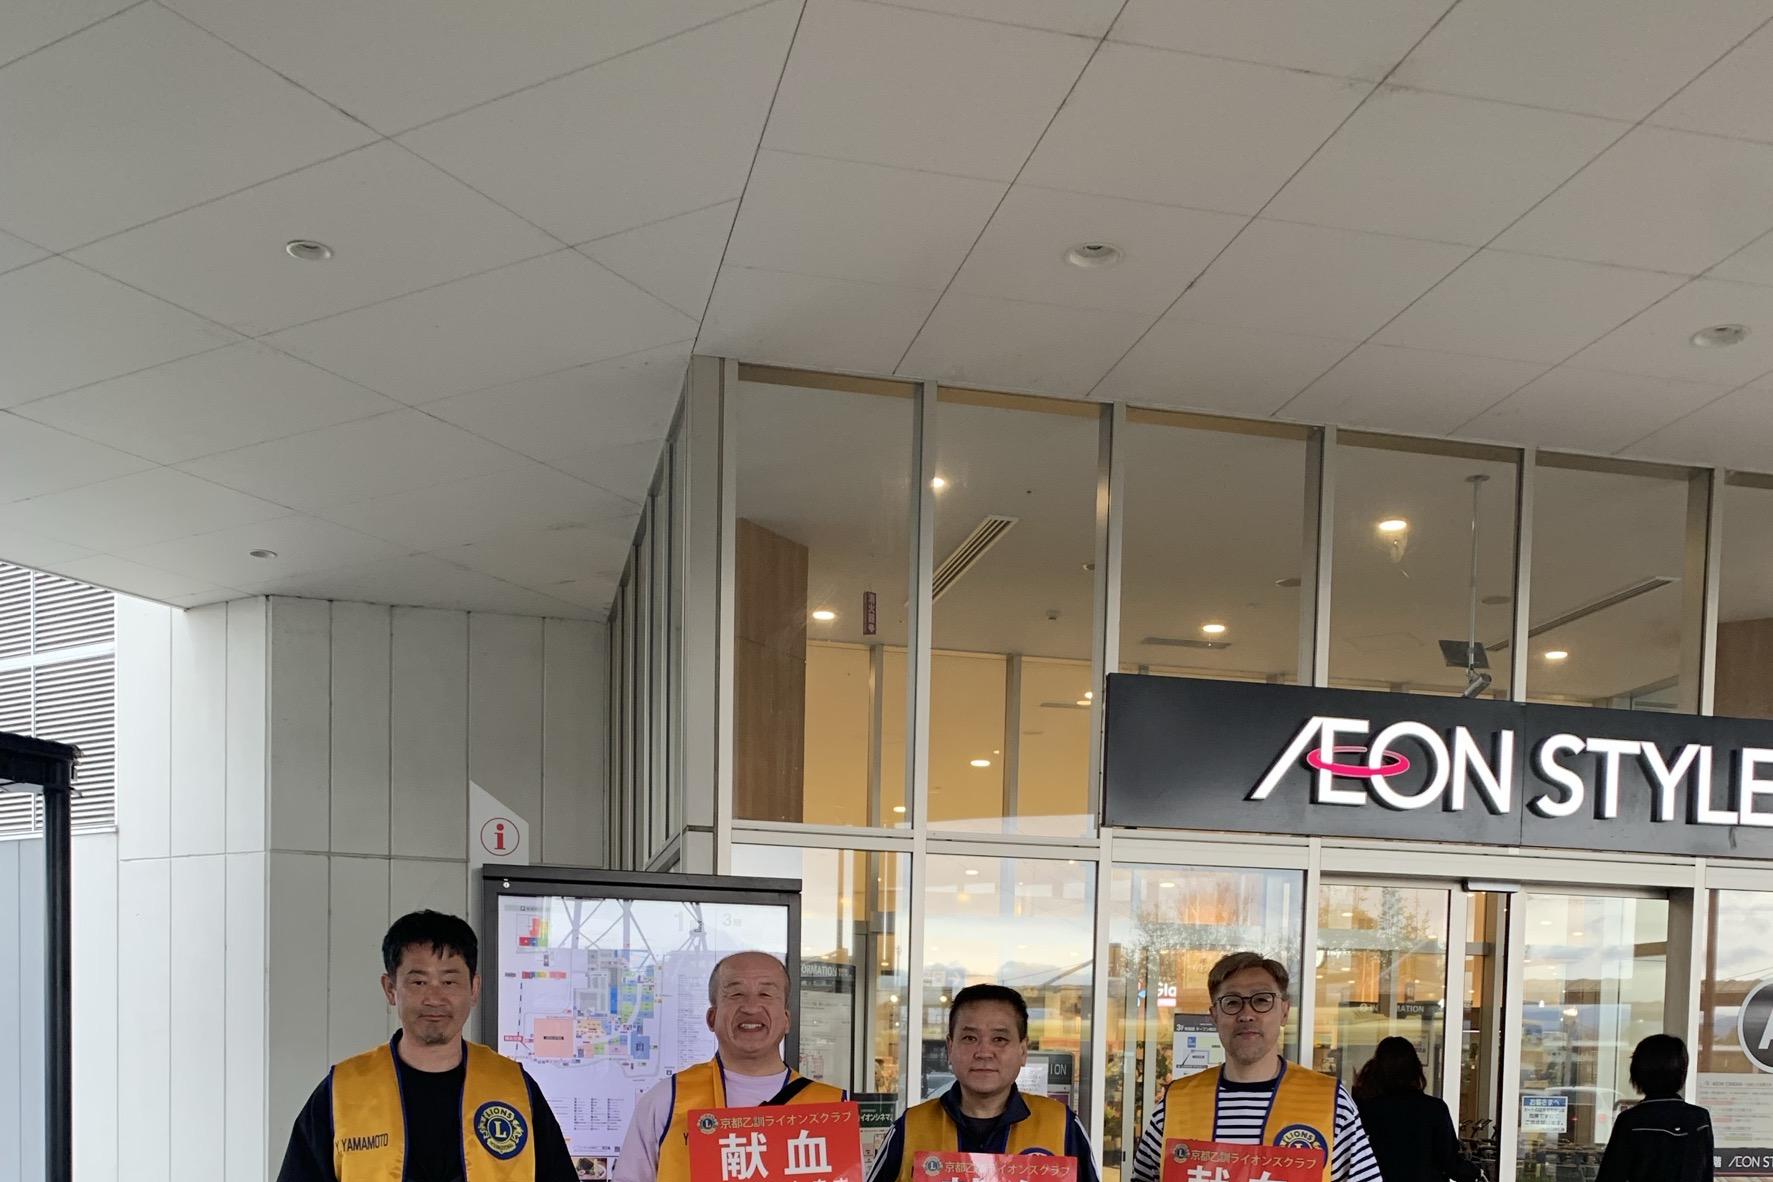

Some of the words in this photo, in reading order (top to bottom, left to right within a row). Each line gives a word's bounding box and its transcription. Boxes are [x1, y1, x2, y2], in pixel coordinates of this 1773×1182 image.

[1535, 733, 1773, 826] STYLE
[801, 964, 838, 977] ORMATION
[1050, 1063, 1067, 1075] ION
[485, 1107, 513, 1119] LIONS
[494, 1120, 507, 1138] L
[1285, 1130, 1314, 1141] LIONS
[719, 1129, 833, 1182] 献血
